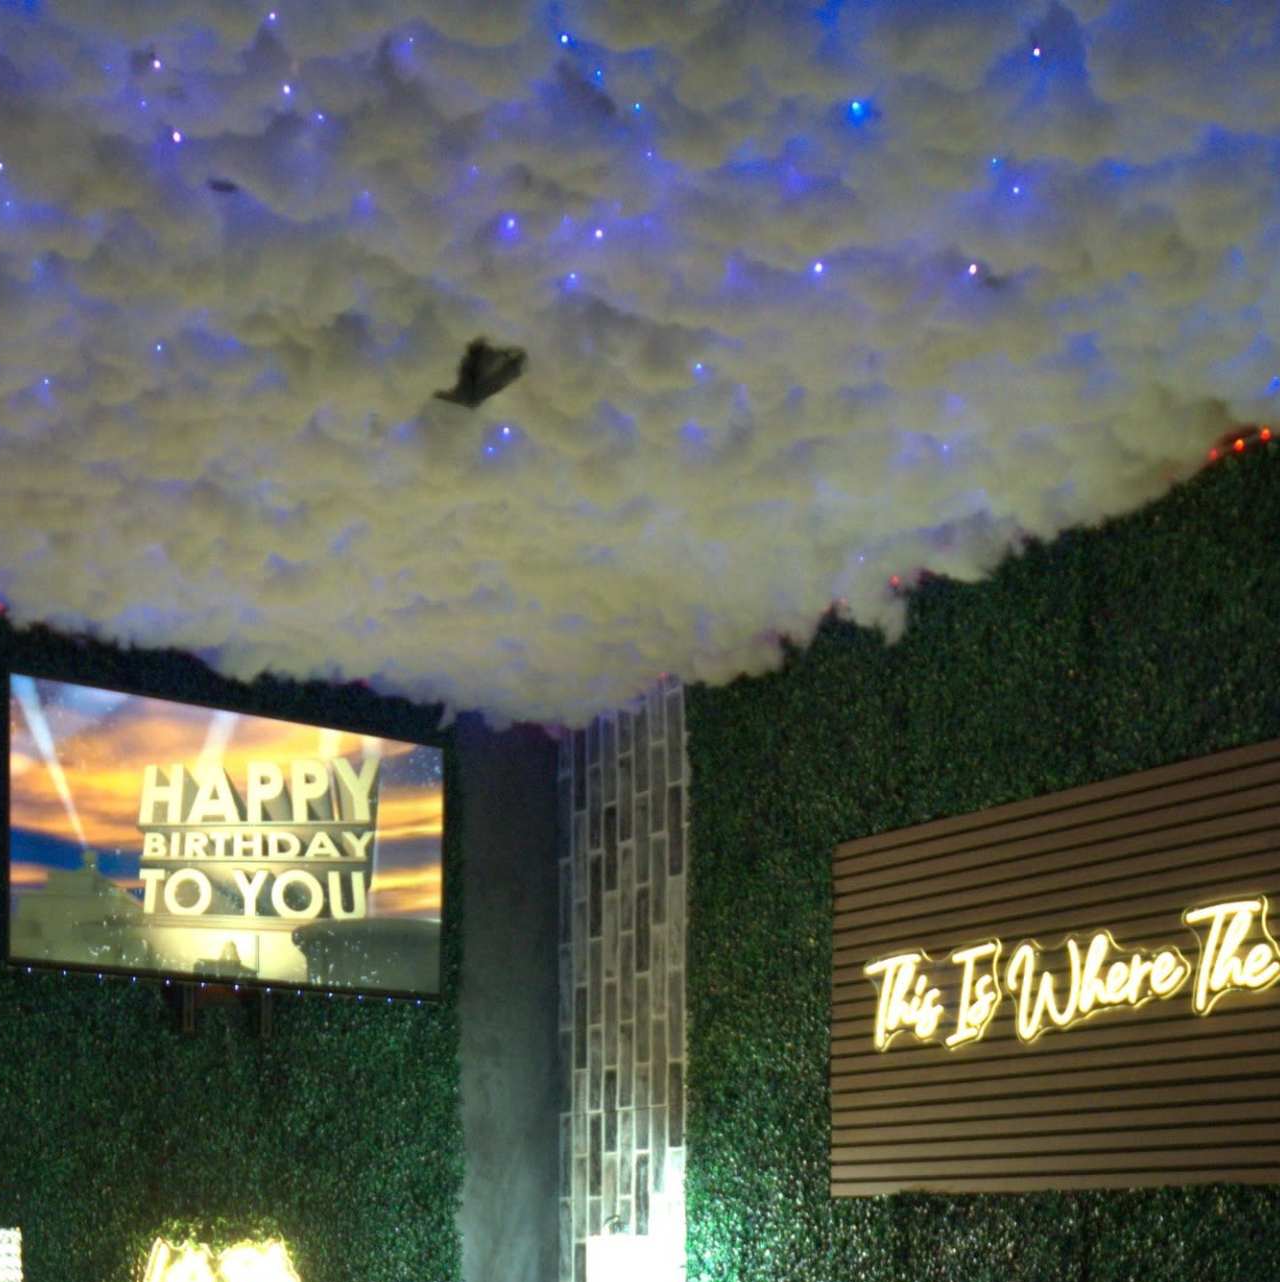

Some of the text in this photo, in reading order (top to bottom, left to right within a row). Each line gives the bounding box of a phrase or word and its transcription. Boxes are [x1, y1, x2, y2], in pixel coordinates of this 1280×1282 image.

[138, 757, 381, 825] HAPPY
[142, 830, 376, 860] BIRTHDAY
[139, 868, 368, 920] TO YOU
[864, 952, 944, 1051] This
[944, 942, 998, 1046] Is
[1007, 932, 1188, 1041] Where
